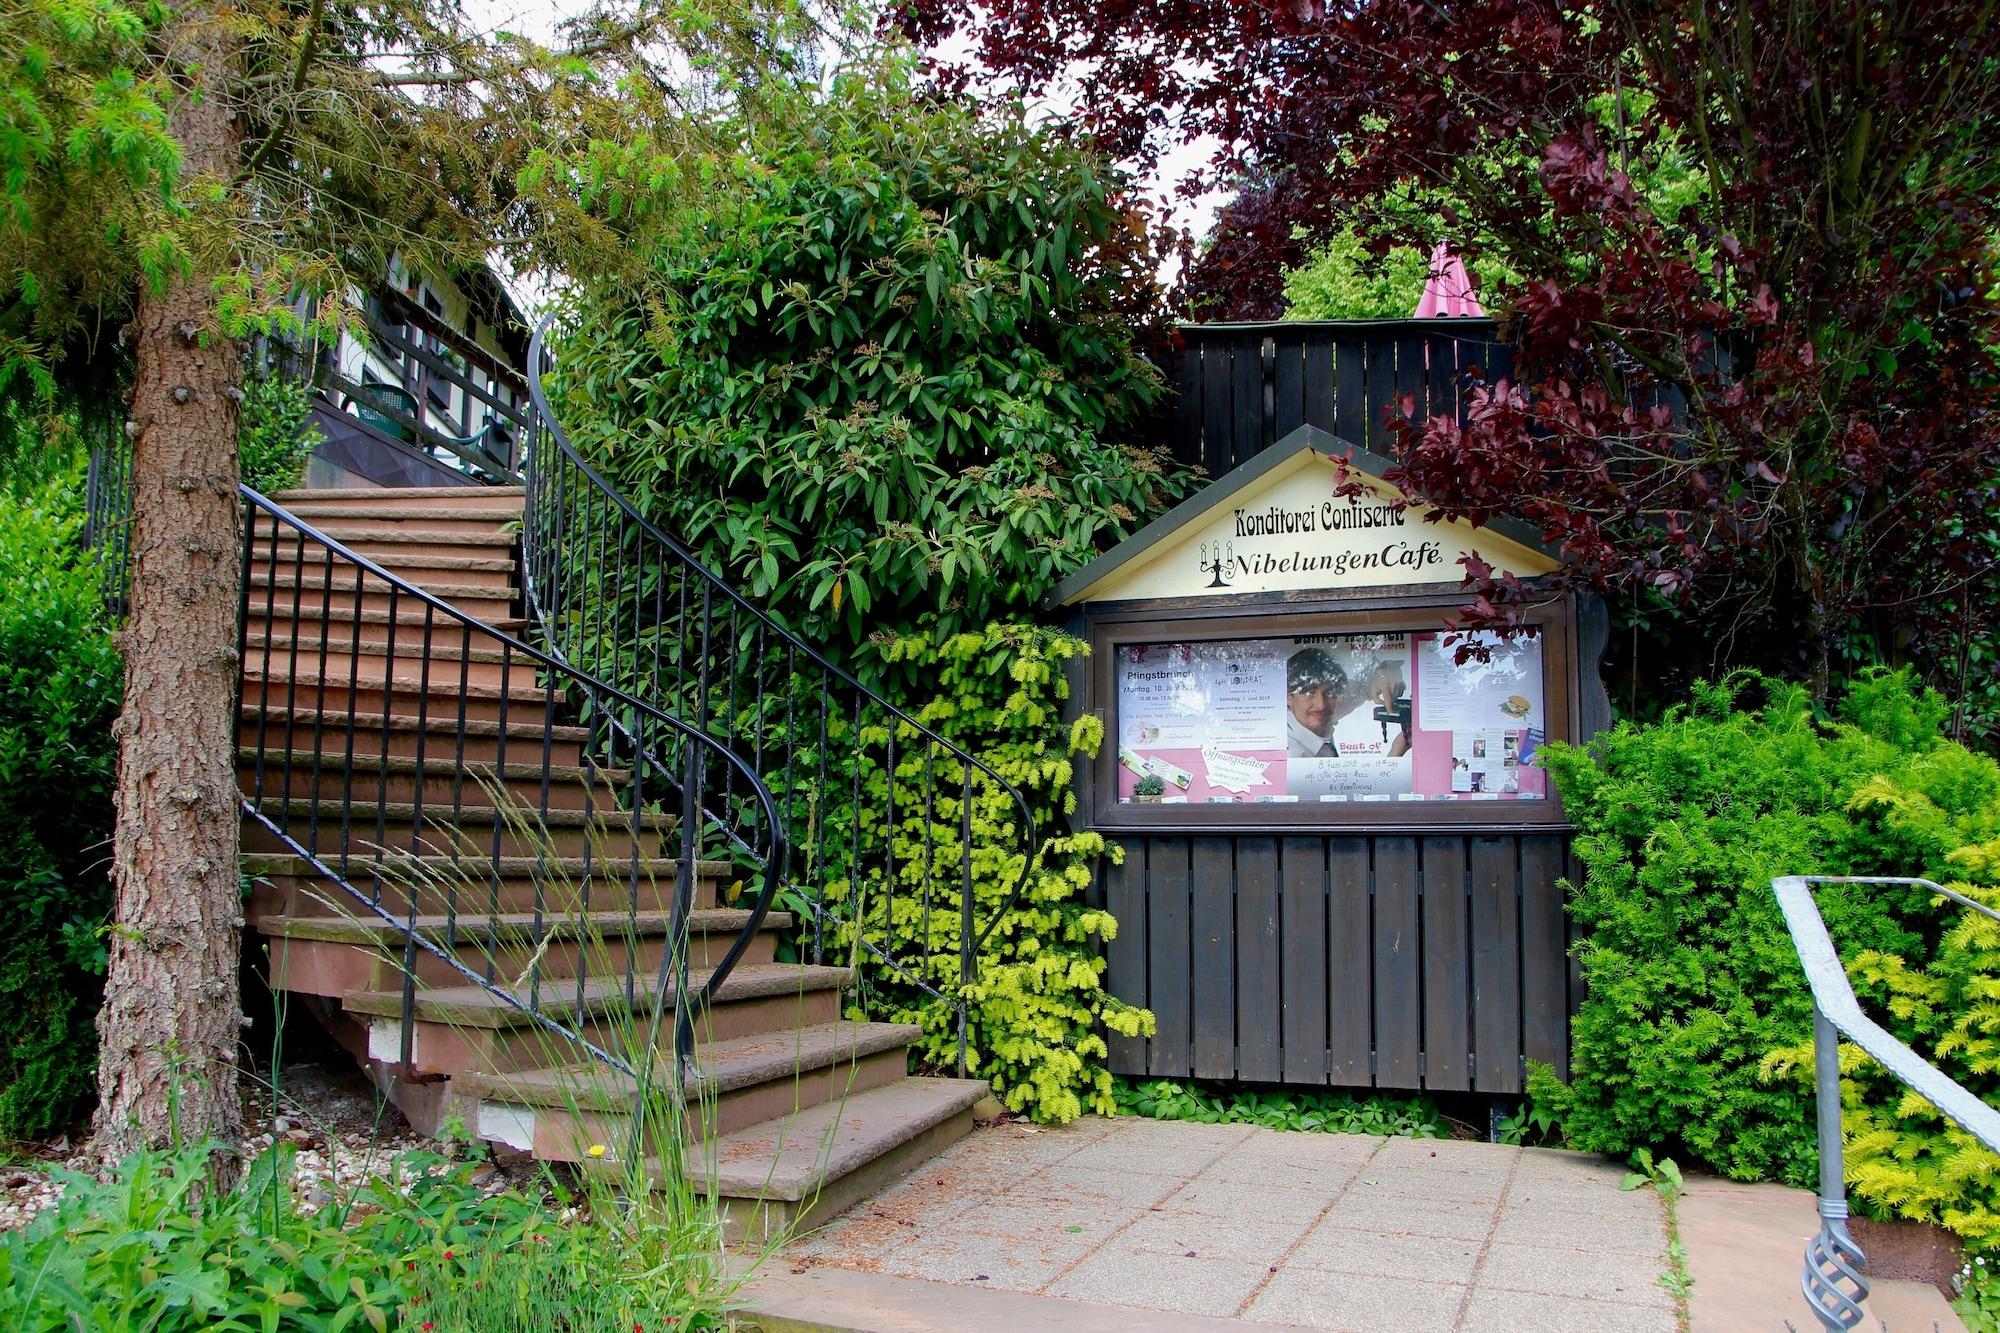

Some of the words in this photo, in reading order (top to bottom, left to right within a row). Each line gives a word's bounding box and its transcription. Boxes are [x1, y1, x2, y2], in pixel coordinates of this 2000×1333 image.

[1234, 504, 1316, 537] Konditorei
[1127, 670, 1194, 682] Pfingstbrunch
[1339, 742, 1365, 750] Best
[1368, 742, 1382, 750] of
